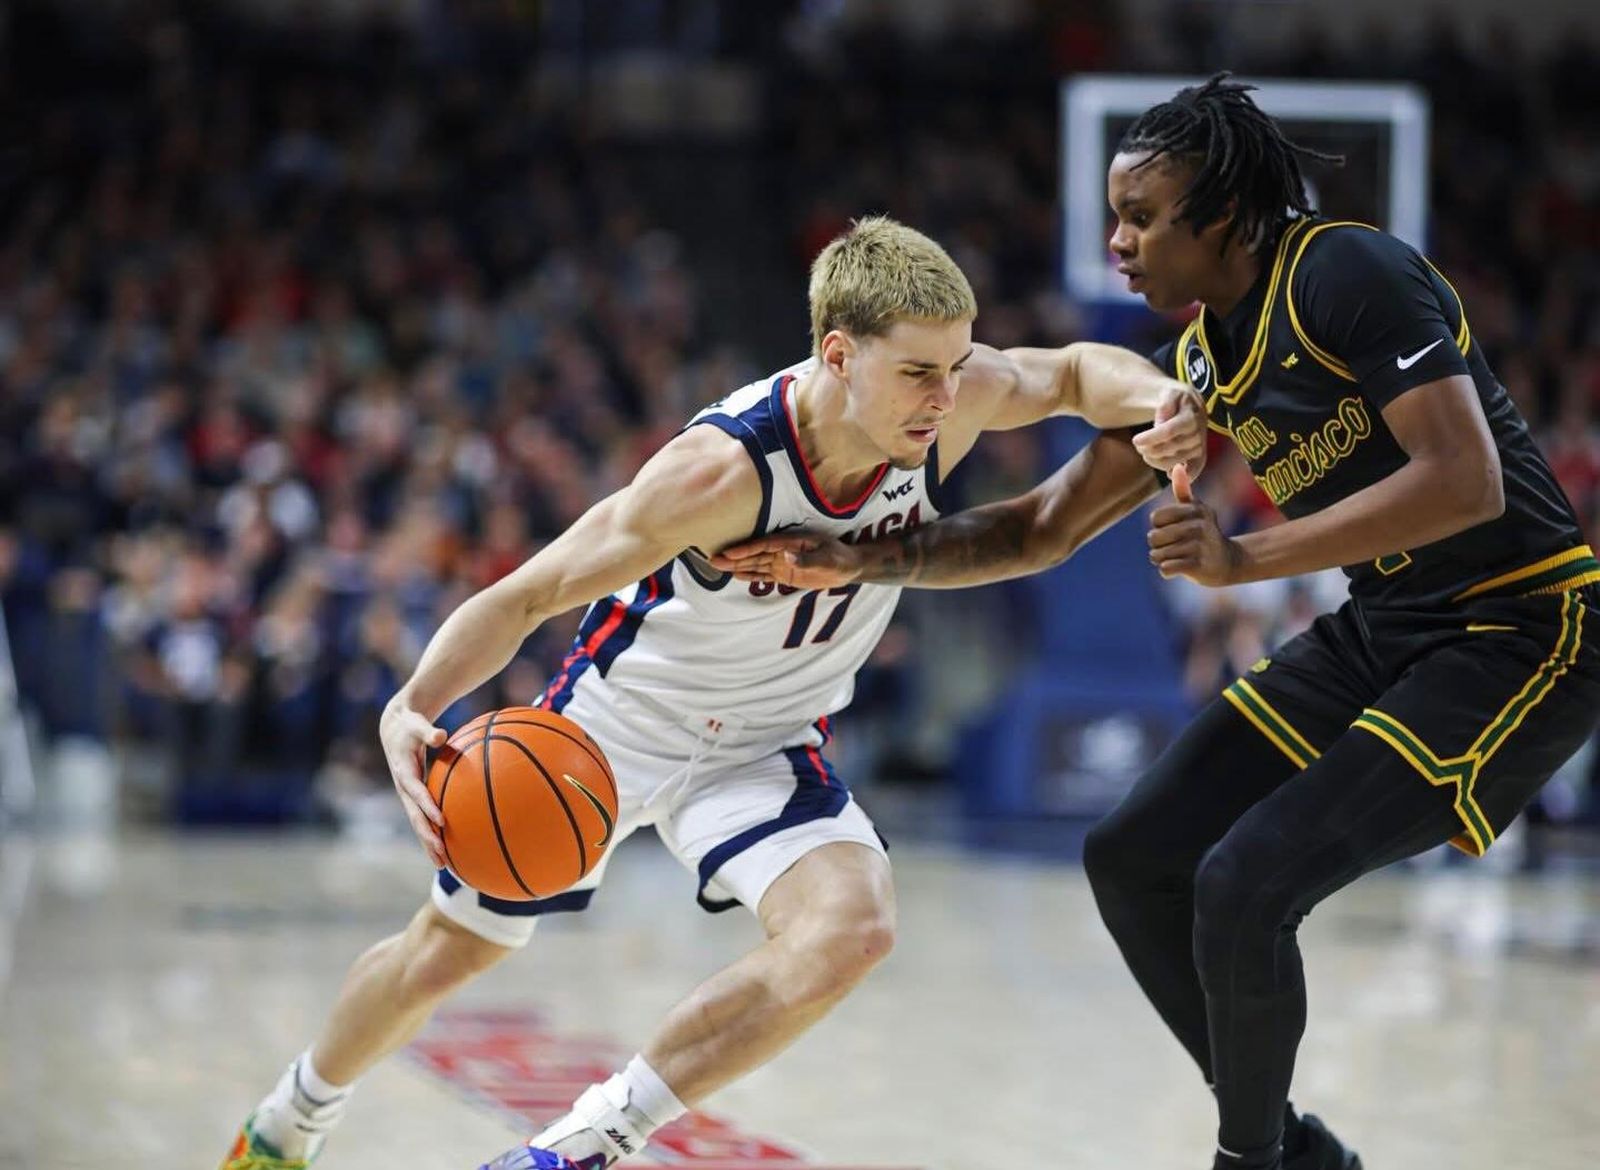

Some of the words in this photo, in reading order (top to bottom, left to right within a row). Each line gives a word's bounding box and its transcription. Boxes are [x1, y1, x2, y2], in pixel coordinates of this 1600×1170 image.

[1189, 355, 1206, 381] LW
[1228, 412, 1277, 460] an
[882, 476, 915, 502] WCC
[782, 582, 862, 650] 17
